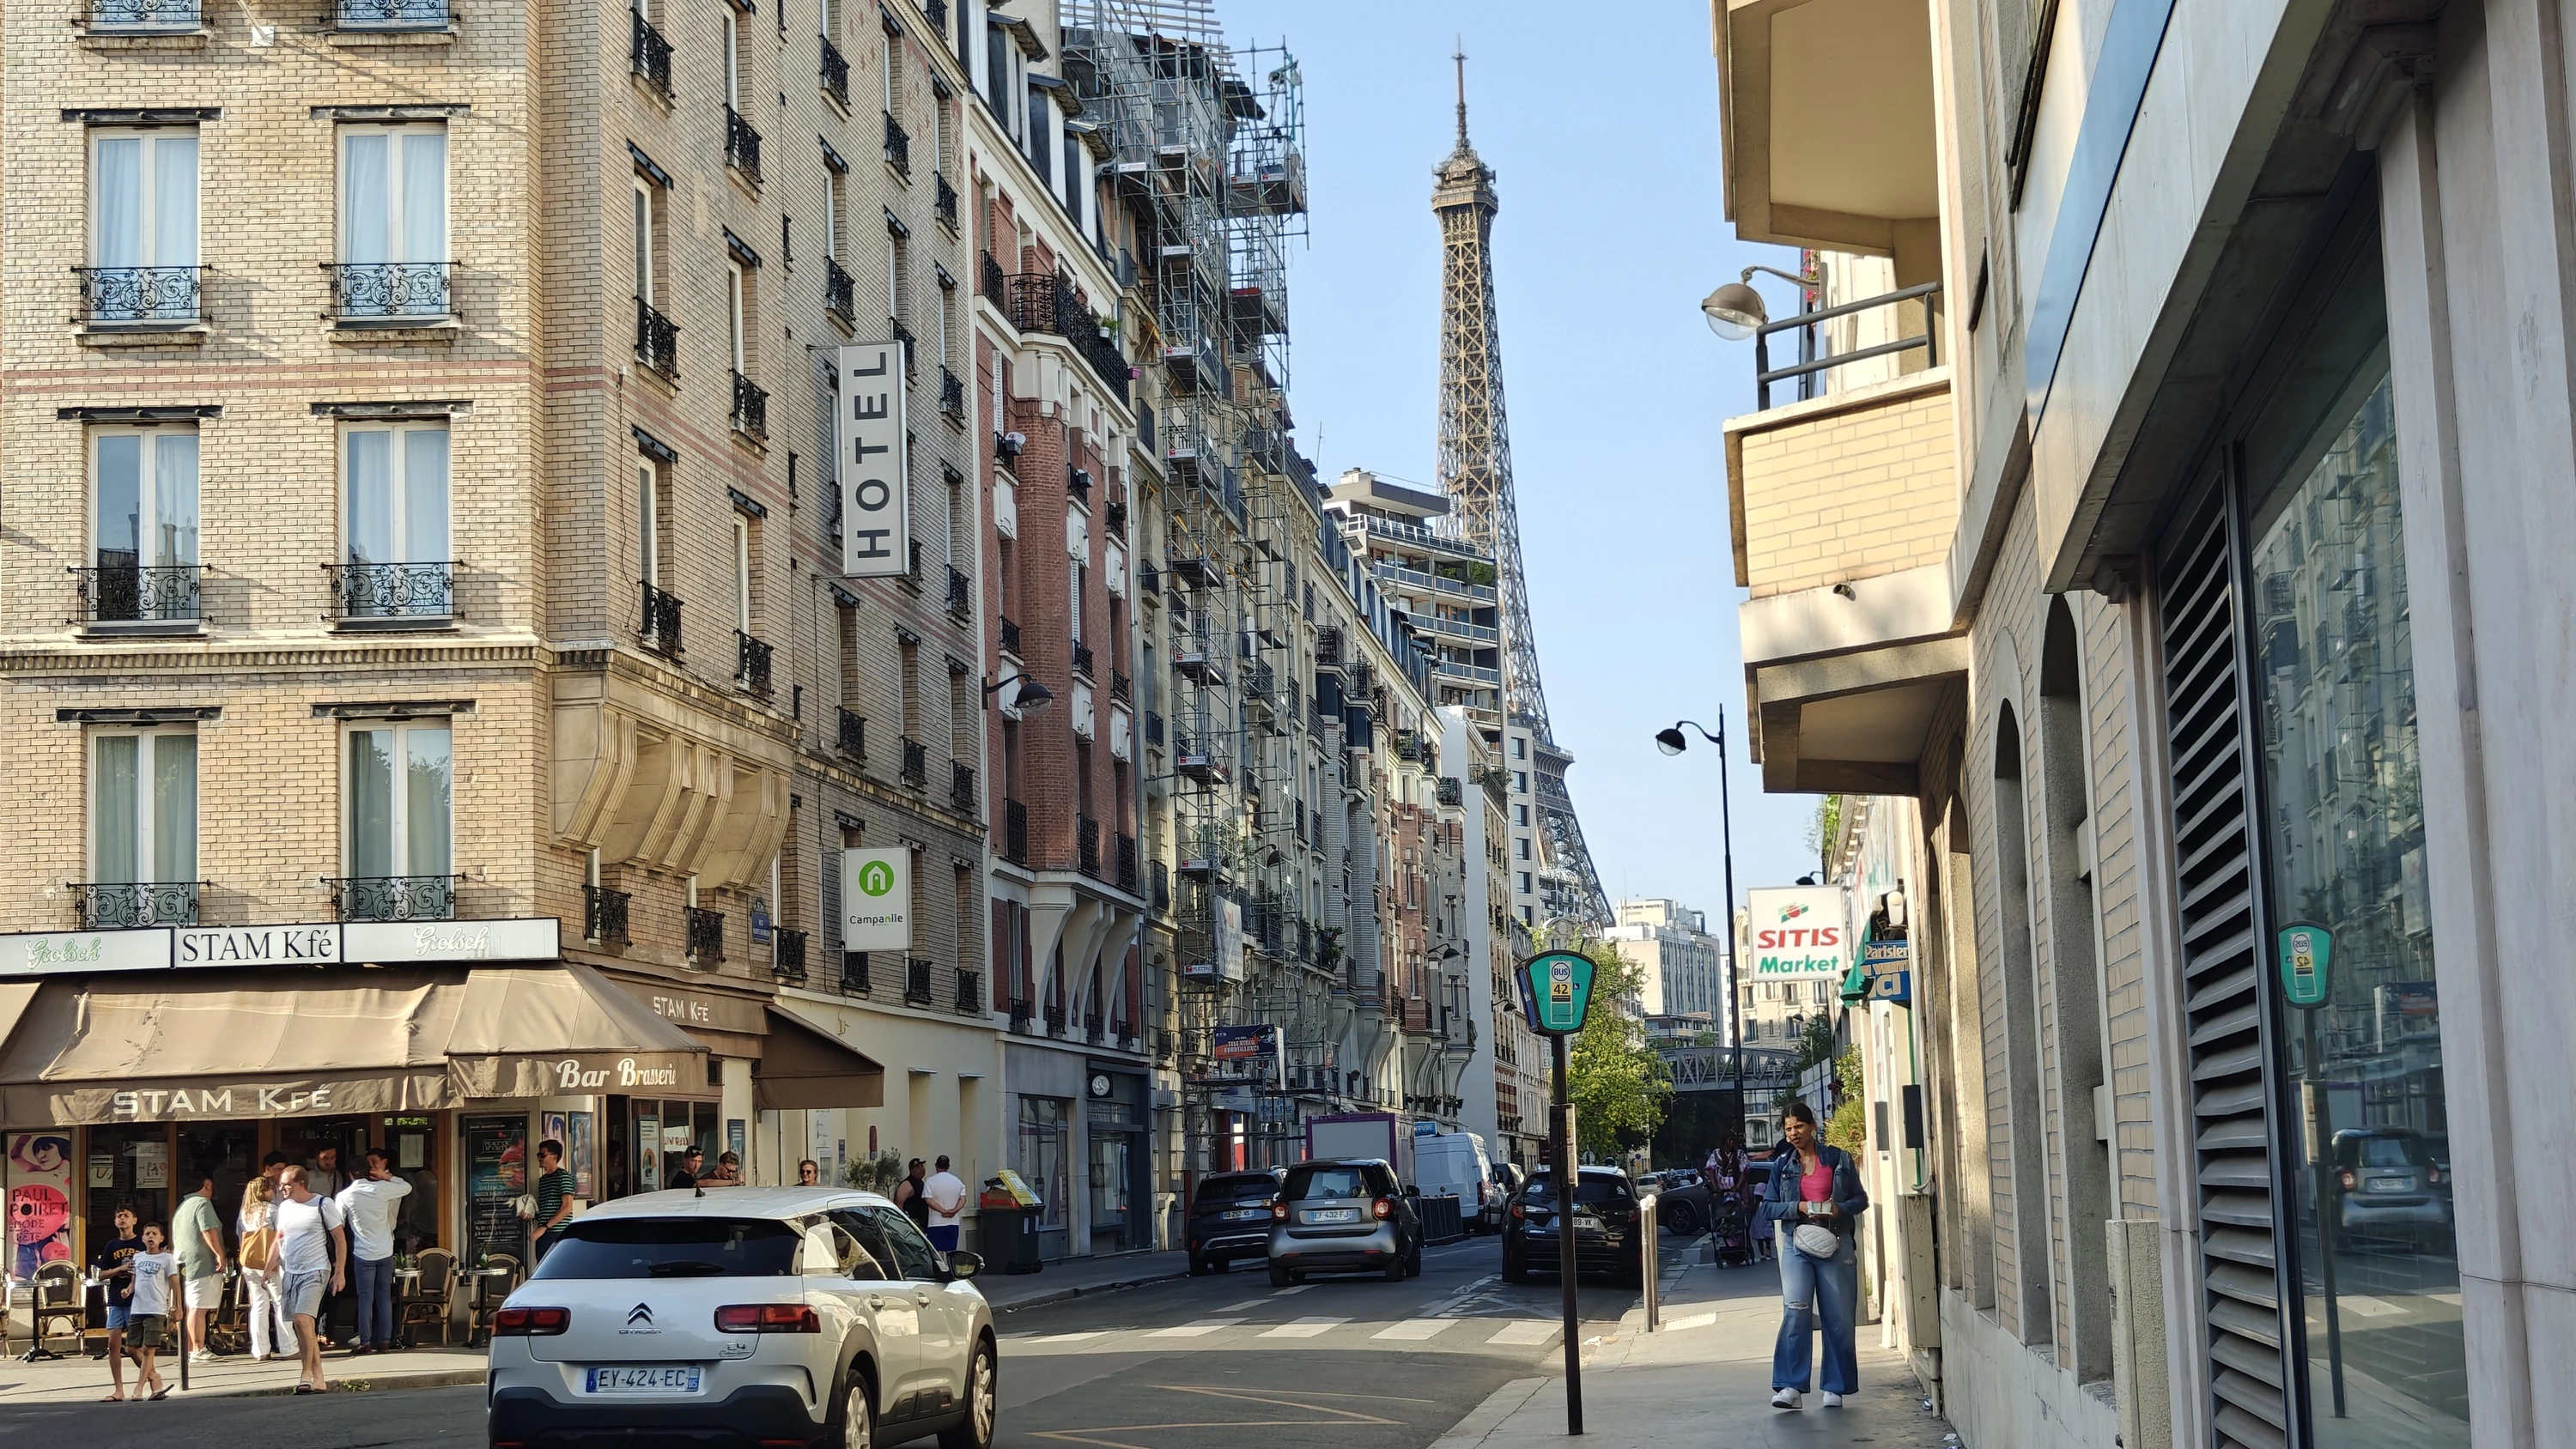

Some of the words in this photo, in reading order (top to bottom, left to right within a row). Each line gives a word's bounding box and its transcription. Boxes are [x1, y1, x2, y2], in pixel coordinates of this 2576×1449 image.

[854, 352, 890, 559] HOTEL
[849, 913, 903, 926] Campanile
[182, 932, 272, 961] STAM
[283, 930, 333, 959] Kfé
[413, 925, 490, 956] Grolsch
[1758, 927, 1839, 949] SITIS
[24, 937, 102, 969] Grolsch
[1759, 955, 1839, 973] Market
[1553, 984, 1569, 994] 42
[653, 996, 685, 1019] STAM
[556, 1058, 611, 1088] Bar
[617, 1058, 677, 1087] Brasserie
[113, 1089, 233, 1114] STAM
[12, 1188, 52, 1202] PAUL
[9, 1201, 68, 1217] POIRET
[598, 1369, 686, 1387] EY-424-EC
